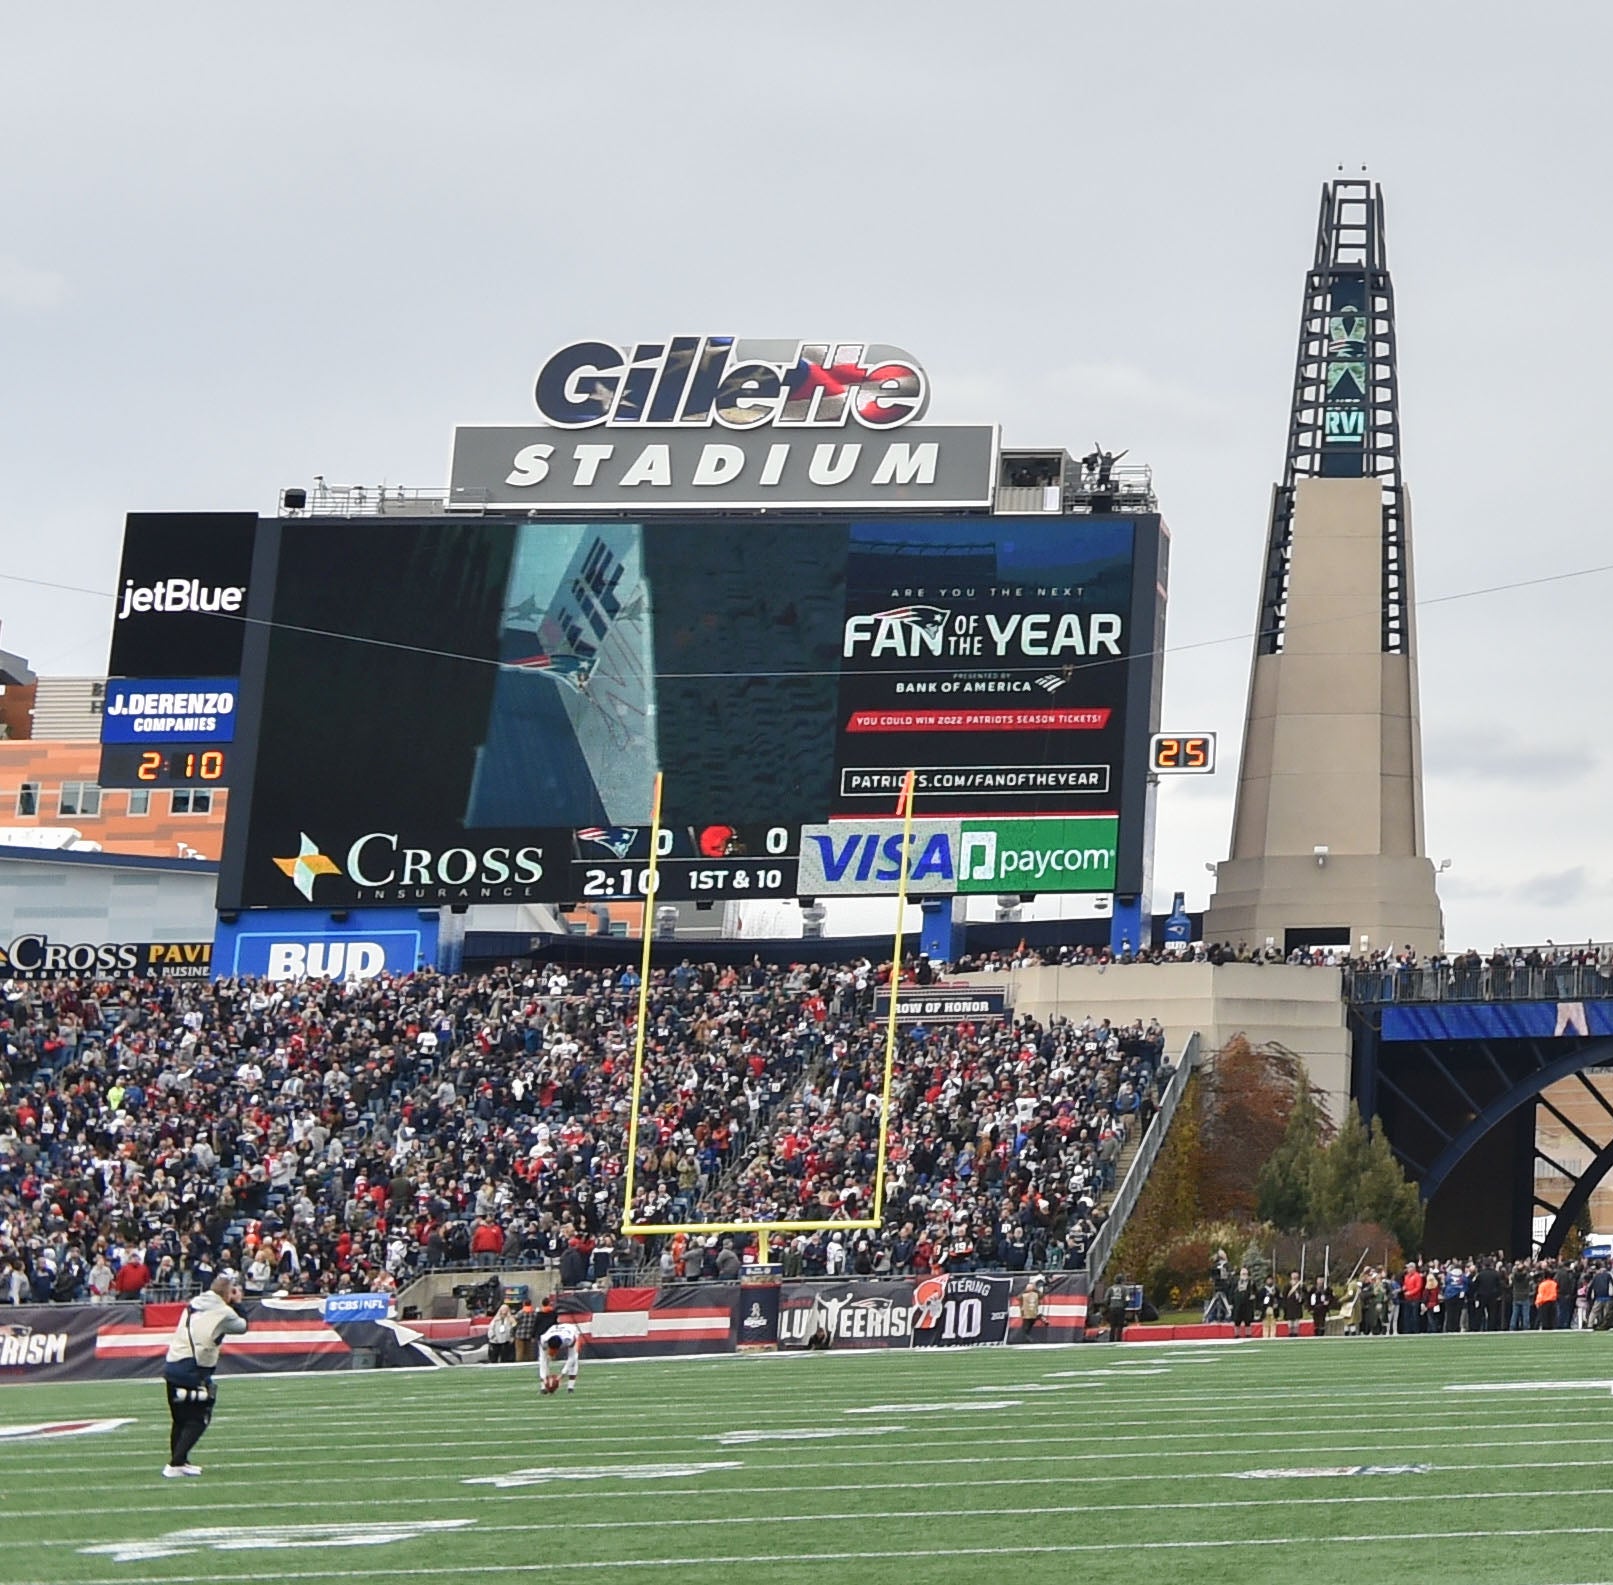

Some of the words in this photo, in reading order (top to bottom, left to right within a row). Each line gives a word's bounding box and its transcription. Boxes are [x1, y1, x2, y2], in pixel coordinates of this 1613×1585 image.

[533, 335, 928, 431] Gillette
[505, 442, 940, 487] STADIUM
[118, 578, 243, 619] jetBlue
[891, 587, 926, 597] ARE
[939, 587, 976, 597] YOU
[990, 587, 1023, 597] THE
[1037, 587, 1085, 597] NEXT
[843, 613, 944, 658] FAN
[954, 615, 979, 635] OF
[985, 613, 1122, 657] YEAR
[948, 636, 984, 656] THE
[895, 682, 937, 694] BANK
[941, 682, 960, 694] OF
[963, 681, 1032, 694] AMERICA
[107, 692, 234, 716] J.DERENZO
[133, 716, 217, 733] COMPANIES
[856, 717, 877, 726] YOU
[880, 717, 913, 726] COULD
[916, 717, 935, 725] WIN
[937, 717, 963, 725] 2022
[966, 716, 1014, 725] PATRIOTS
[1016, 715, 1056, 725] SEASON
[1058, 714, 1102, 724] TICKETS!
[137, 751, 225, 781] 2:10
[1157, 738, 1206, 767] 25
[656, 827, 674, 856] 0
[766, 827, 788, 854] 0
[347, 831, 544, 887] CROSS
[805, 833, 954, 882] VISA
[1000, 843, 1109, 879] paycom
[356, 886, 534, 899] INSURANCE
[583, 868, 661, 896] 2:10
[689, 869, 729, 890] 1ST
[733, 870, 750, 889] &
[754, 869, 783, 889] 10
[8, 933, 138, 971] CROSS
[267, 941, 386, 983] BUD
[146, 966, 156, 978] &
[894, 1001, 922, 1015] ROW
[924, 1001, 940, 1015] OF
[943, 1000, 990, 1014] HONOR
[337, 1299, 359, 1312] CBS
[363, 1298, 386, 1310] NFL
[941, 1298, 982, 1340] 10
